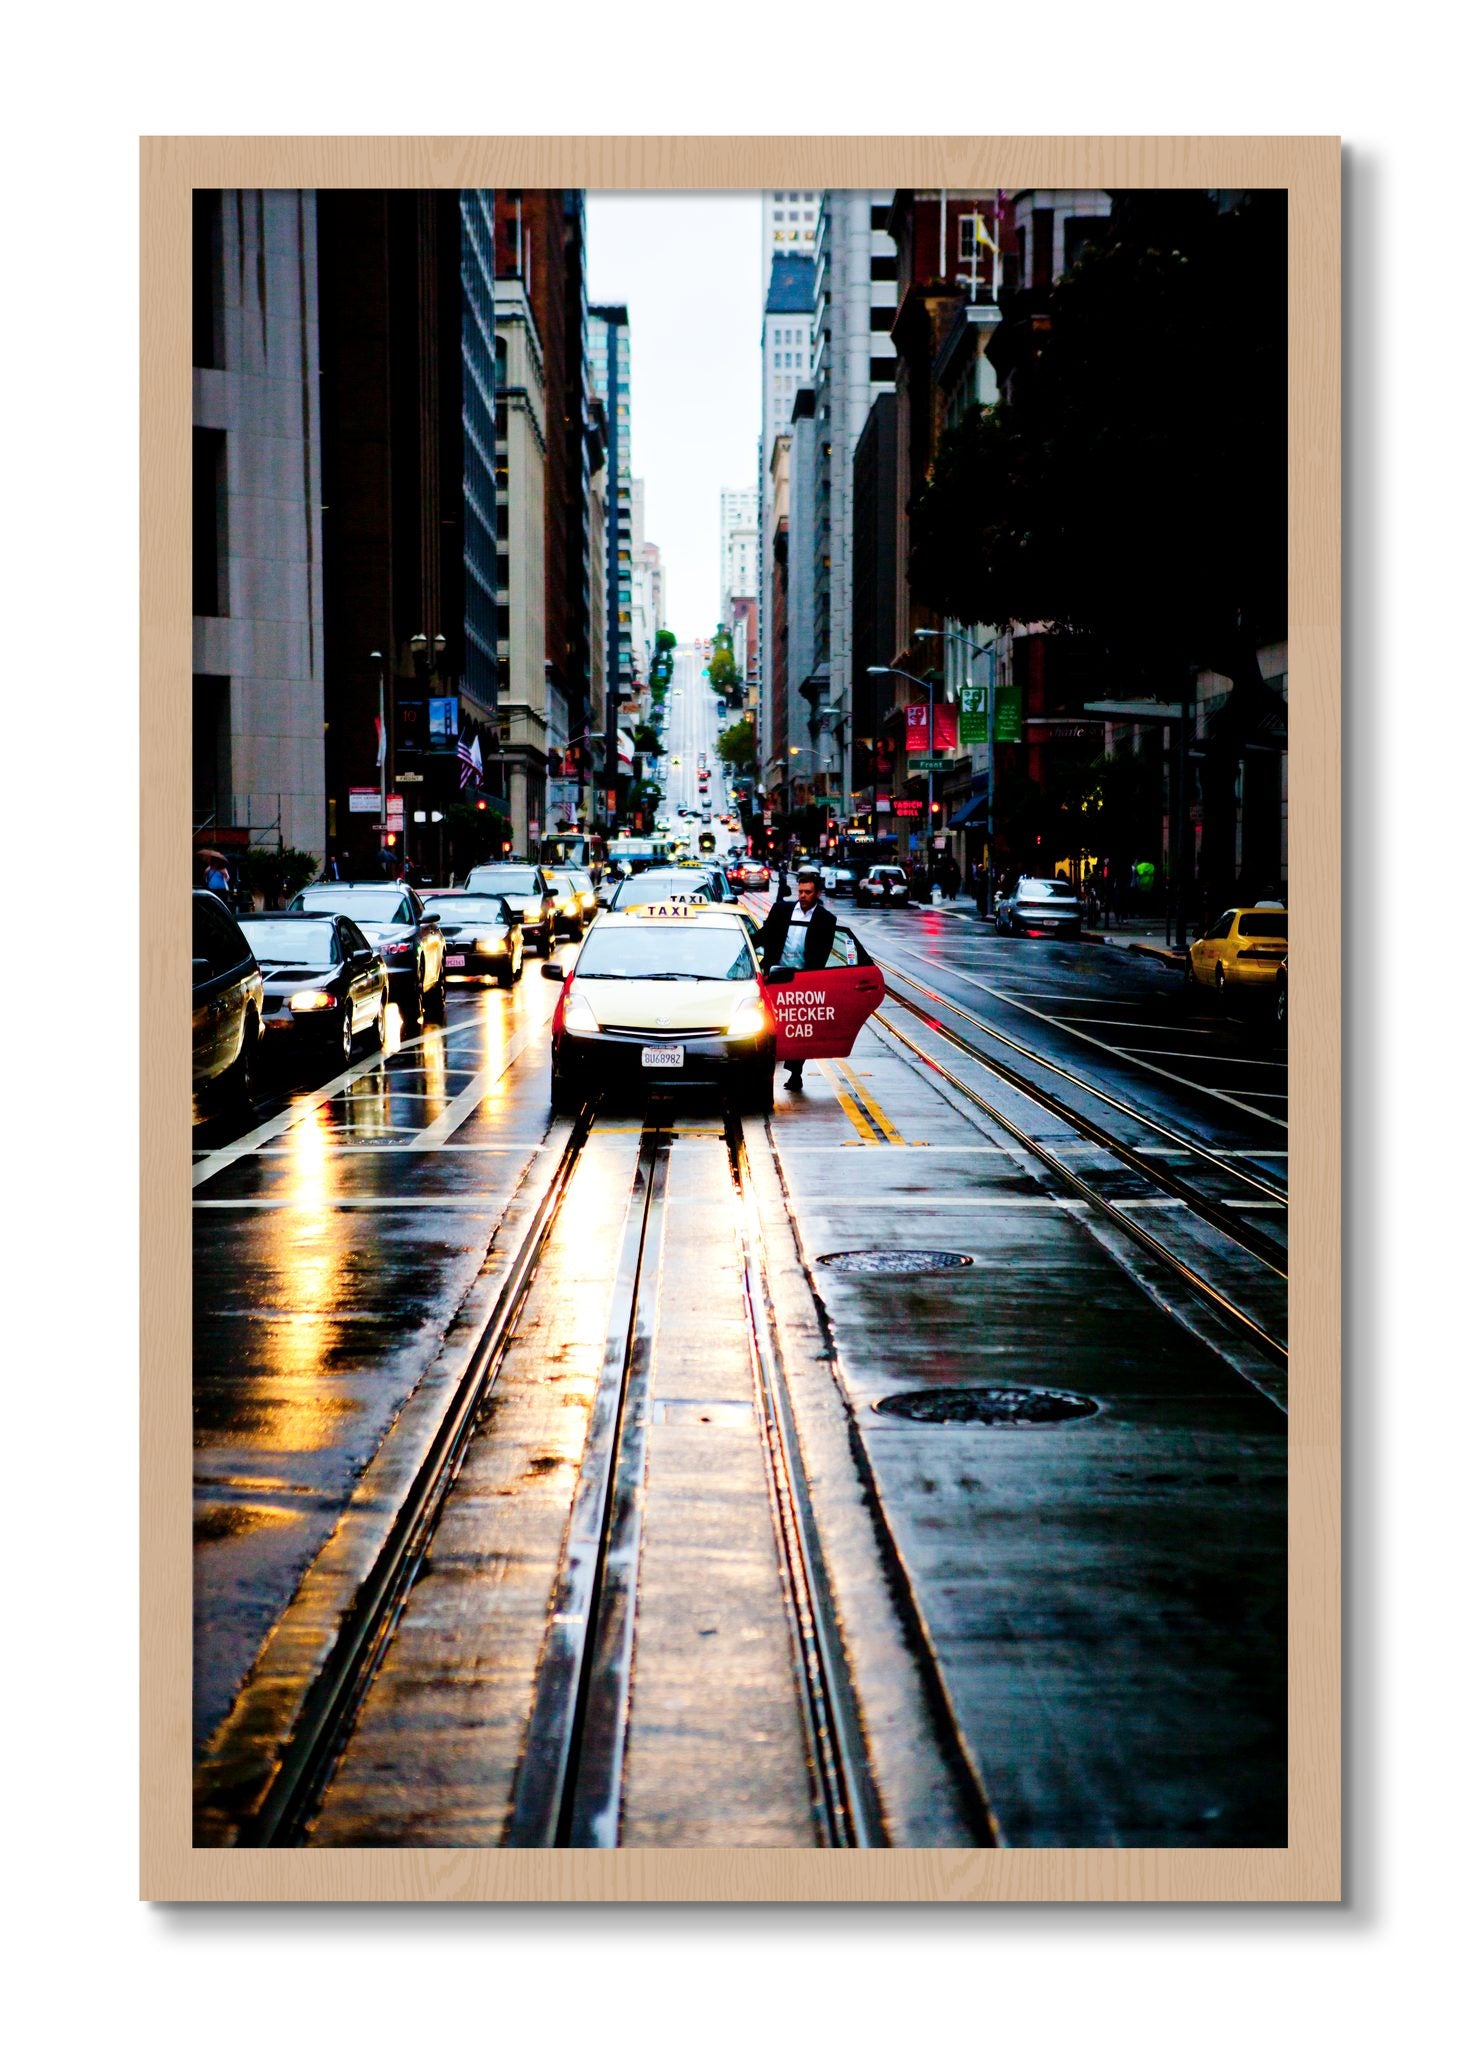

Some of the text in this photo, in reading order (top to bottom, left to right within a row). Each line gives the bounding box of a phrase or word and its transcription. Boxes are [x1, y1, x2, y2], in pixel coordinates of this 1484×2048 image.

[670, 895, 703, 903] TAXI
[648, 906, 688, 916] TAXI
[776, 991, 826, 1006] ARROW
[785, 1024, 814, 1038] CAB
